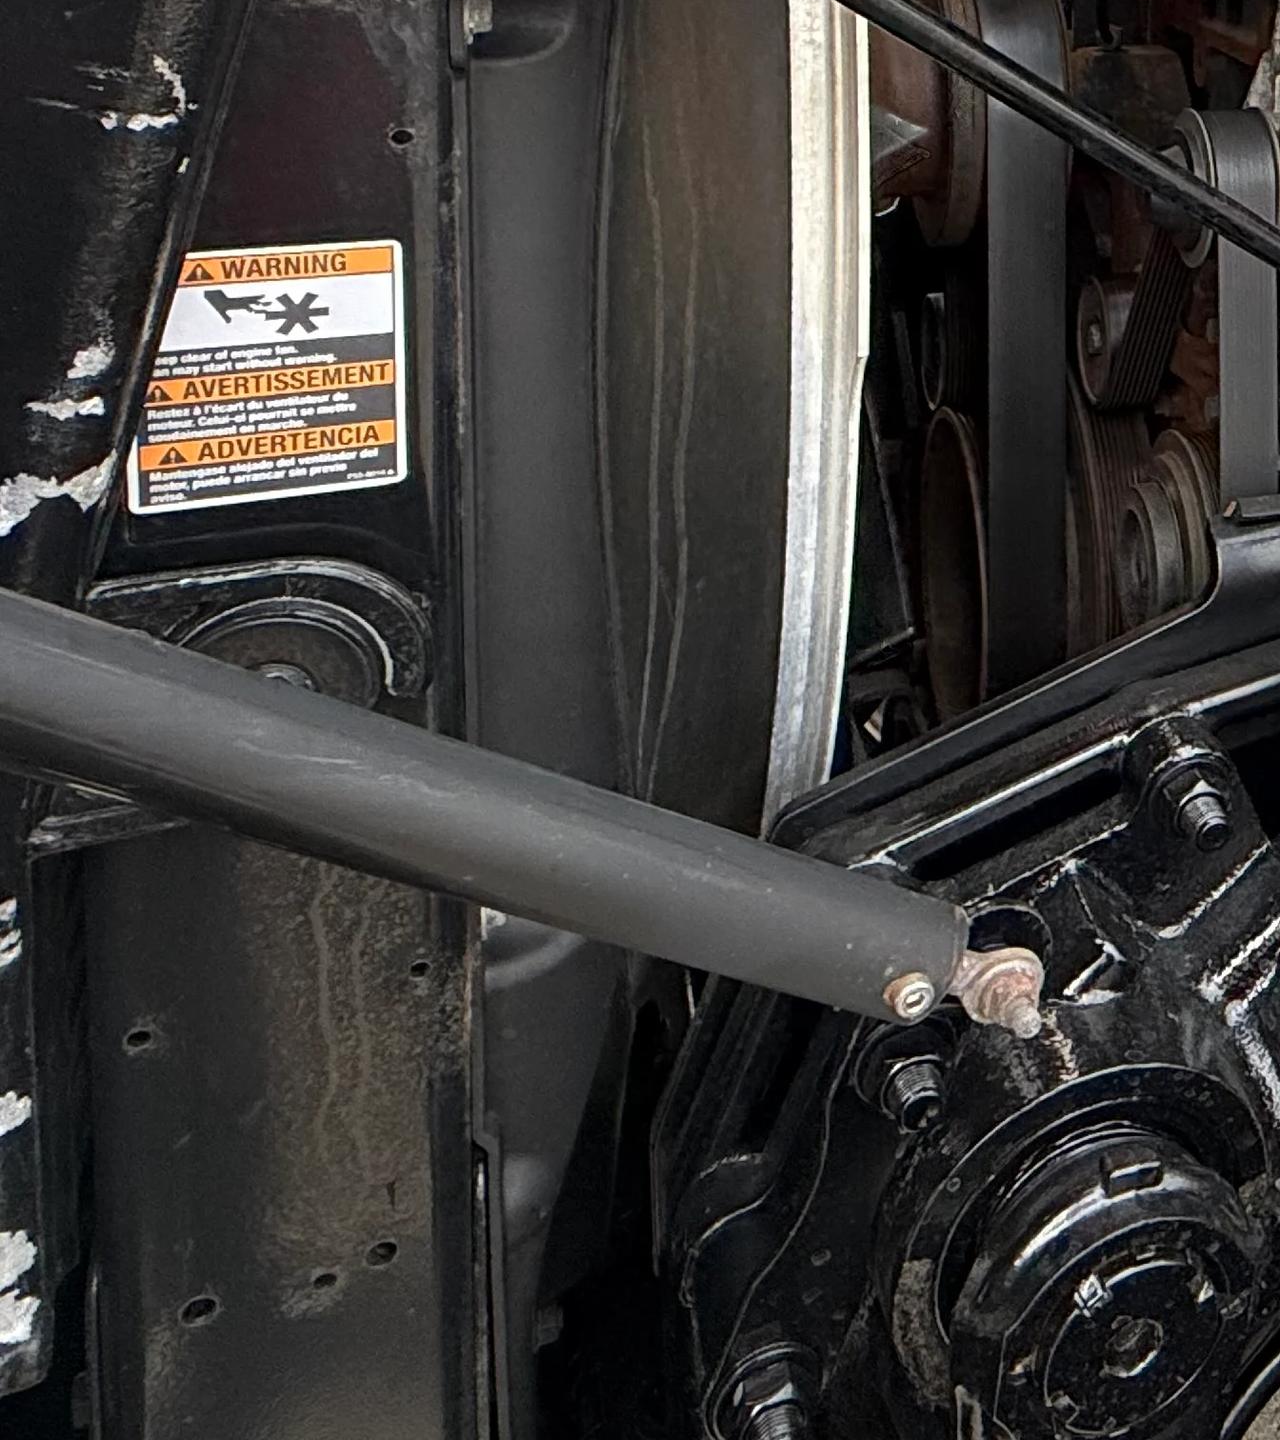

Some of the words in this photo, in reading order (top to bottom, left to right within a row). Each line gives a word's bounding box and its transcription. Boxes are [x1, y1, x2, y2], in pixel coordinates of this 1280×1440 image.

[220, 252, 347, 280] WARNING
[152, 368, 170, 378] an
[172, 366, 200, 377] may
[202, 361, 234, 373] start
[235, 356, 283, 370] without
[284, 352, 338, 365] warning.
[154, 355, 178, 366] eep
[180, 353, 213, 364] clear
[214, 349, 229, 360] of
[230, 347, 273, 359] engine
[183, 362, 390, 400] AVERTISSEMENT
[147, 407, 191, 420] Restez
[265, 394, 331, 409] ventilateur
[248, 407, 299, 423] pourrait
[299, 406, 316, 417] se
[316, 402, 358, 415] mettre
[198, 425, 381, 462] ADVERTENCIA
[233, 469, 287, 484] arrancar
[287, 466, 308, 478] sin
